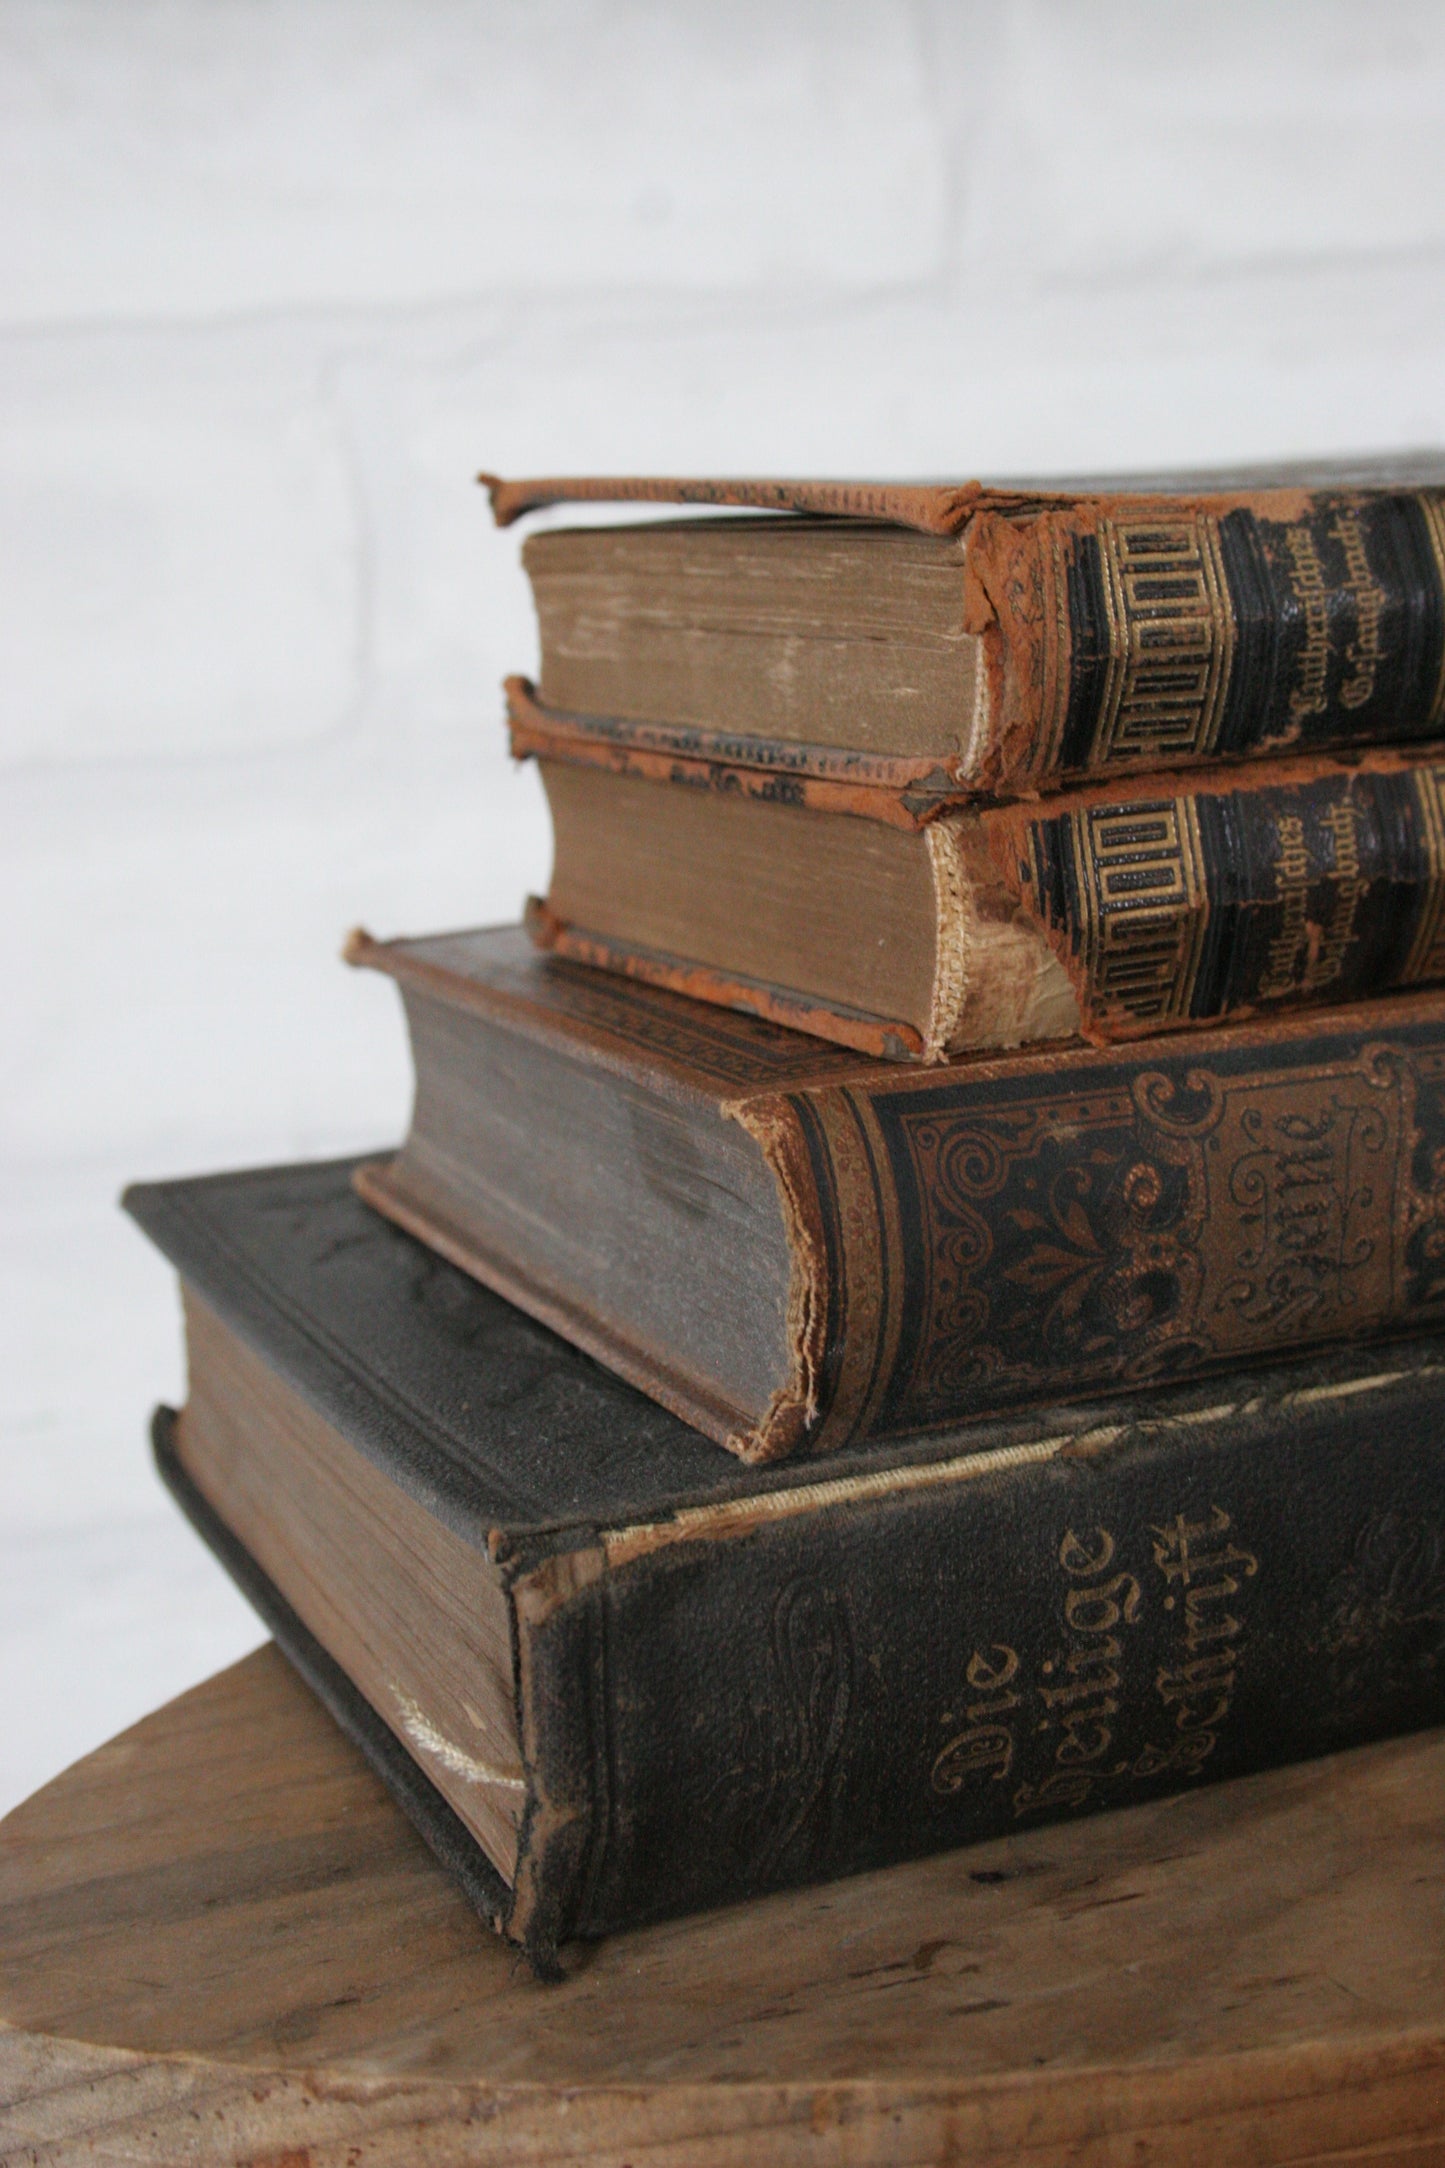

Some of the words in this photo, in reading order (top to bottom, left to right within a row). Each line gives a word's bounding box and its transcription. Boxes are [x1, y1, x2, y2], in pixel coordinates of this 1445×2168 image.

[931, 1643, 1020, 1795] Die
[1012, 1525, 1142, 1818] Heilige
[1133, 1505, 1259, 1778] Schrift
